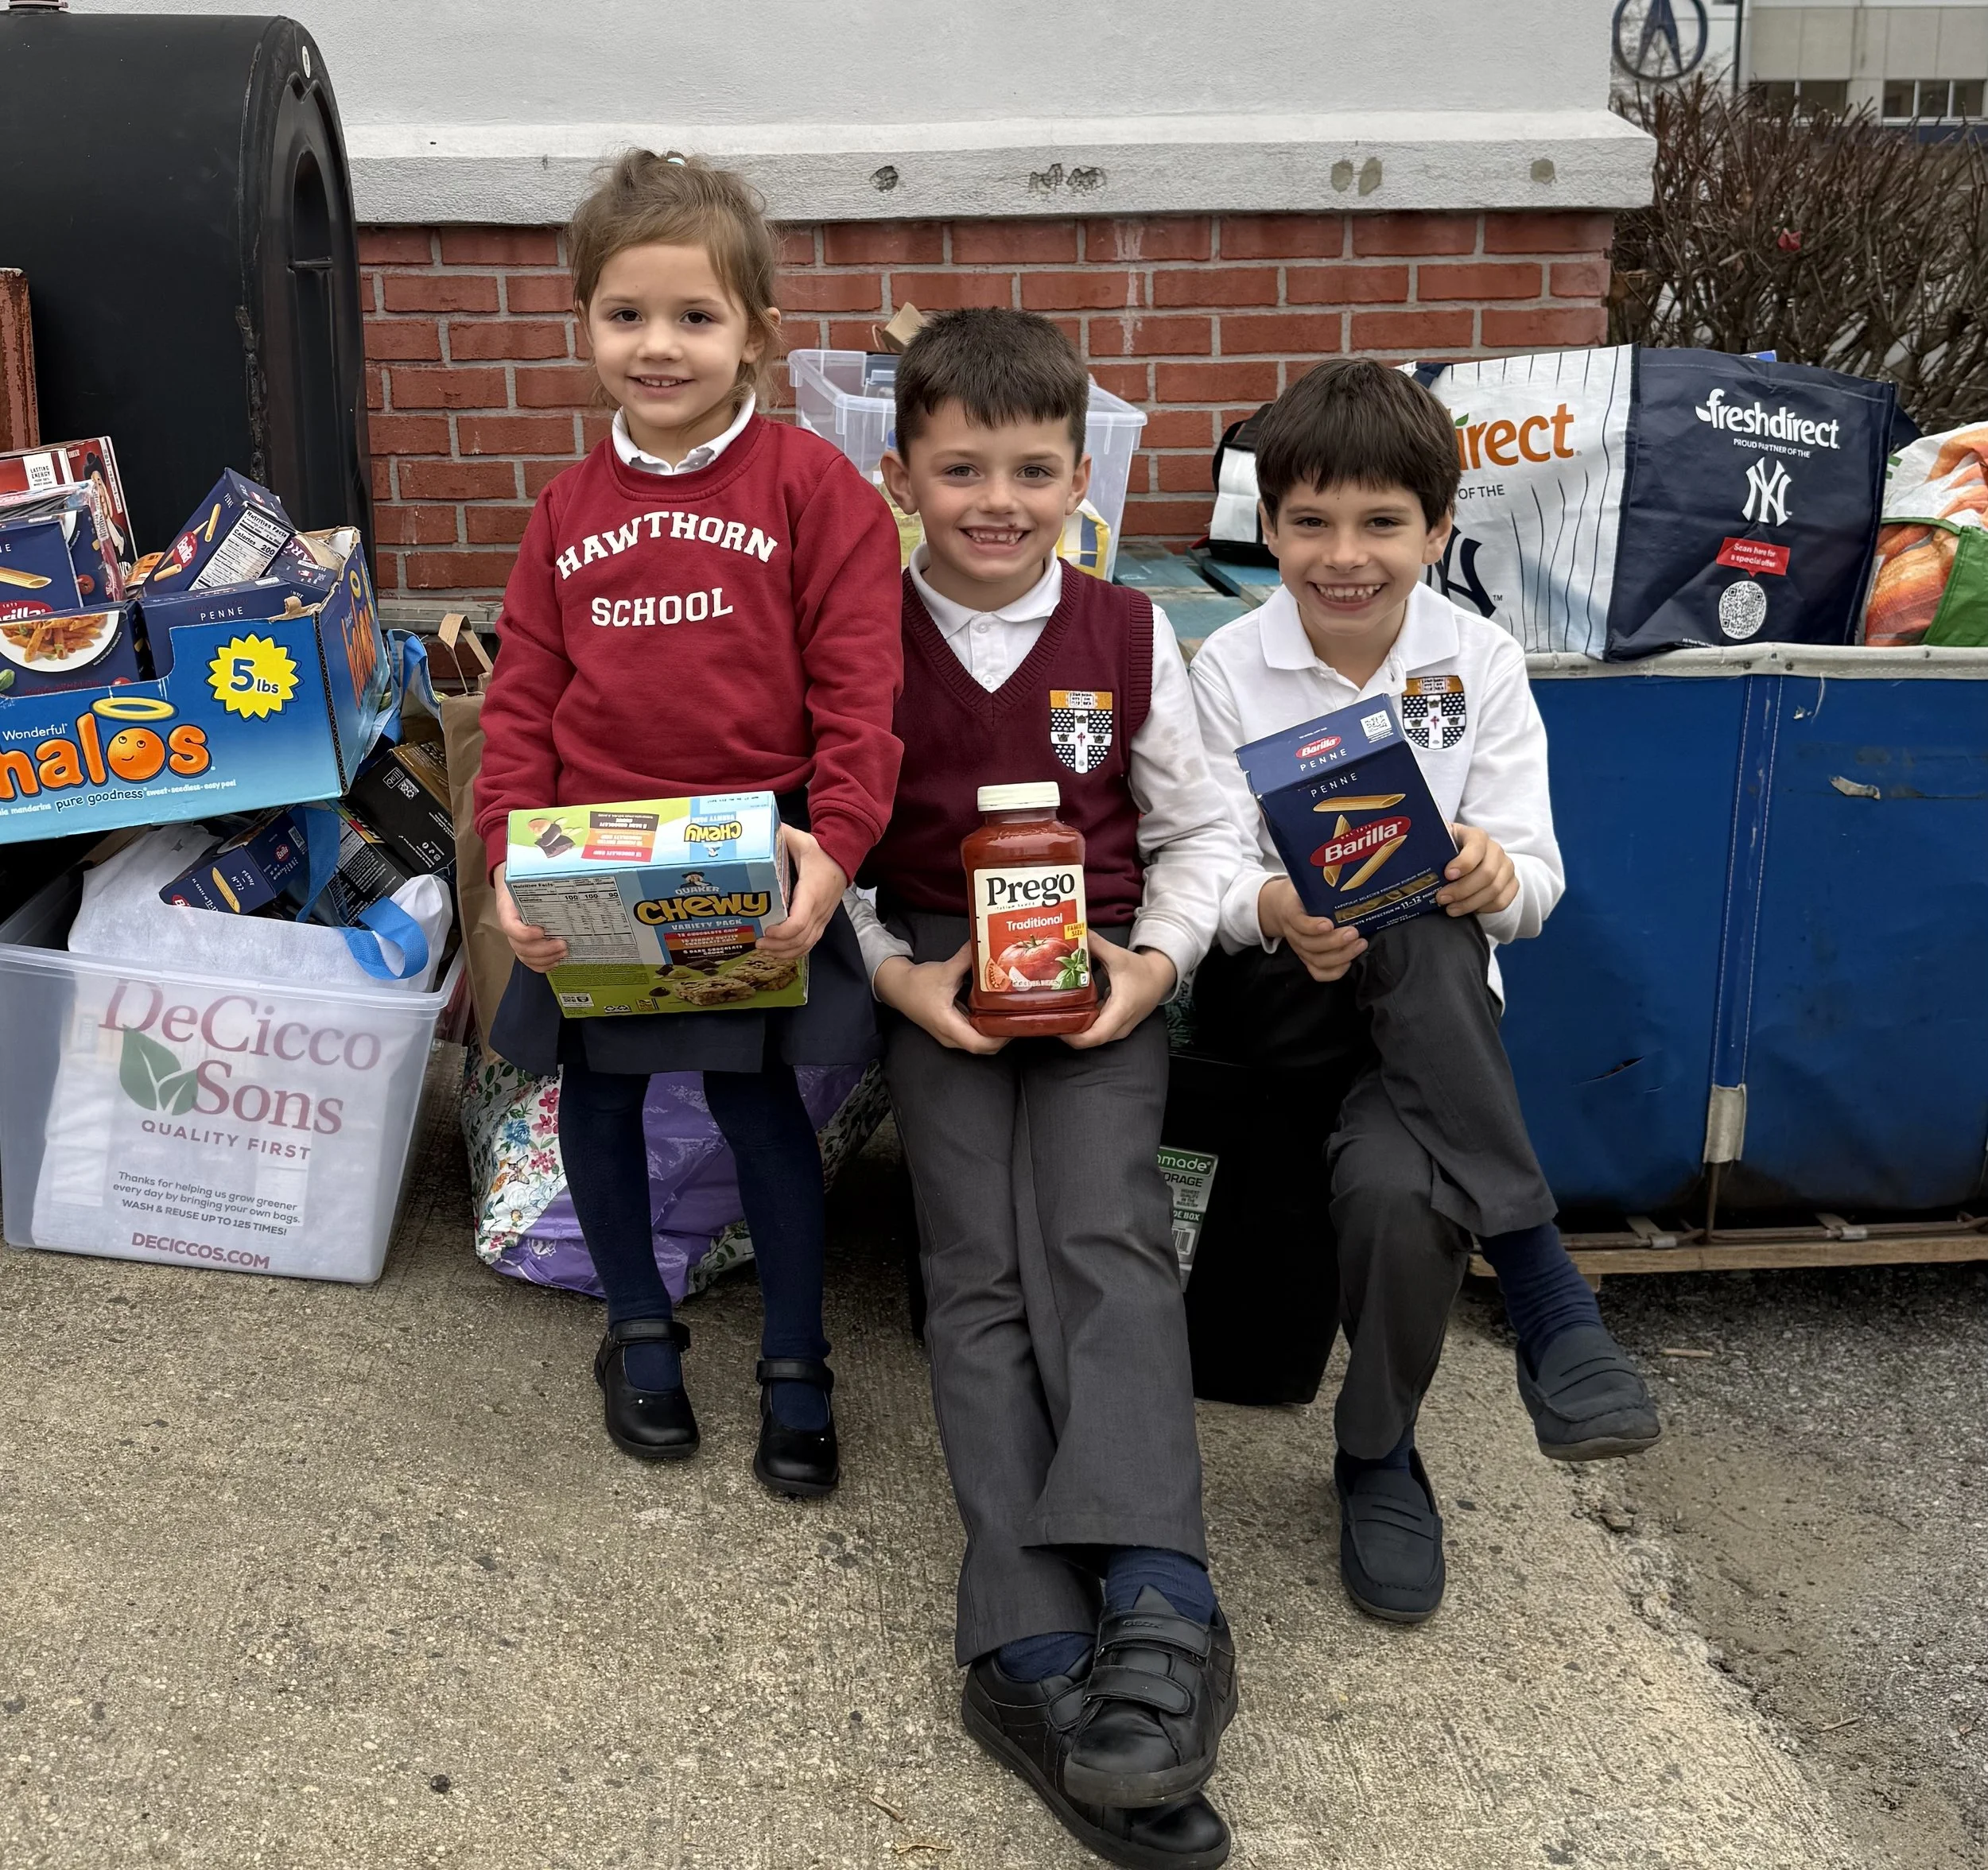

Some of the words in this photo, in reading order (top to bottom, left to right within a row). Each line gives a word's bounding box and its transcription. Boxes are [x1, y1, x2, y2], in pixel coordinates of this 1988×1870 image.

[1706, 388, 1839, 448] freshdirect
[1454, 403, 1574, 471] irect
[1734, 438, 1757, 449] PROUD
[1758, 442, 1787, 454] PARTNER
[1787, 448, 1797, 456] OF
[1797, 449, 1810, 459] THE
[1458, 487, 1476, 499] OF
[1477, 484, 1505, 498] THE
[247, 510, 271, 530] Nutrition
[272, 526, 287, 538] Facts
[260, 544, 275, 556] 200
[557, 511, 778, 580] HAWTHORN
[1734, 543, 1752, 553] Scan
[1753, 547, 1767, 556] here
[1736, 555, 1761, 565] special
[1761, 559, 1776, 568] offer
[200, 606, 244, 621] PENNE
[592, 588, 733, 627] SCHOOL
[231, 659, 255, 692] 5
[257, 679, 278, 693] lbs
[2, 724, 65, 741] Wonderful
[1302, 738, 1338, 757] Barilla
[1299, 749, 1347, 771] PENNE
[171, 784, 200, 793] seedless
[204, 782, 220, 791] easy
[221, 779, 236, 790] peel
[1310, 772, 1357, 797] PENNE
[11, 803, 51, 815] mandarins
[56, 795, 83, 812] pure
[88, 790, 143, 805] goodness
[1326, 824, 1397, 863] Barilla
[242, 870, 254, 887] PENNE
[675, 886, 720, 895] QUAKER
[986, 874, 1075, 908] Prego
[1400, 896, 1422, 908] 11-12
[1006, 913, 1063, 932] Traditional
[99, 978, 381, 1070] DeCicco
[192, 1060, 344, 1135] Sons
[141, 1119, 239, 1148] QUALITY
[247, 1138, 311, 1161] FIRST
[118, 1171, 155, 1185] Thanks
[158, 1179, 173, 1189] for
[175, 1182, 212, 1198] helping
[215, 1189, 227, 1199] us
[229, 1193, 254, 1205] grow
[256, 1197, 297, 1212] greener
[113, 1184, 142, 1196] every
[144, 1188, 162, 1199] day
[165, 1191, 178, 1203] by
[180, 1194, 222, 1212] bringing
[224, 1203, 248, 1213] your
[250, 1208, 270, 1218] own
[273, 1212, 301, 1224] bags.
[122, 1199, 153, 1212] WASH
[165, 1207, 199, 1220] REUSE
[201, 1214, 216, 1223] UP
[217, 1216, 231, 1226] TO
[233, 1219, 250, 1229] 125
[253, 1223, 287, 1236] TIMES!
[1183, 1211, 1200, 1221] BOX
[131, 1232, 270, 1269] DECICCOS.COM
